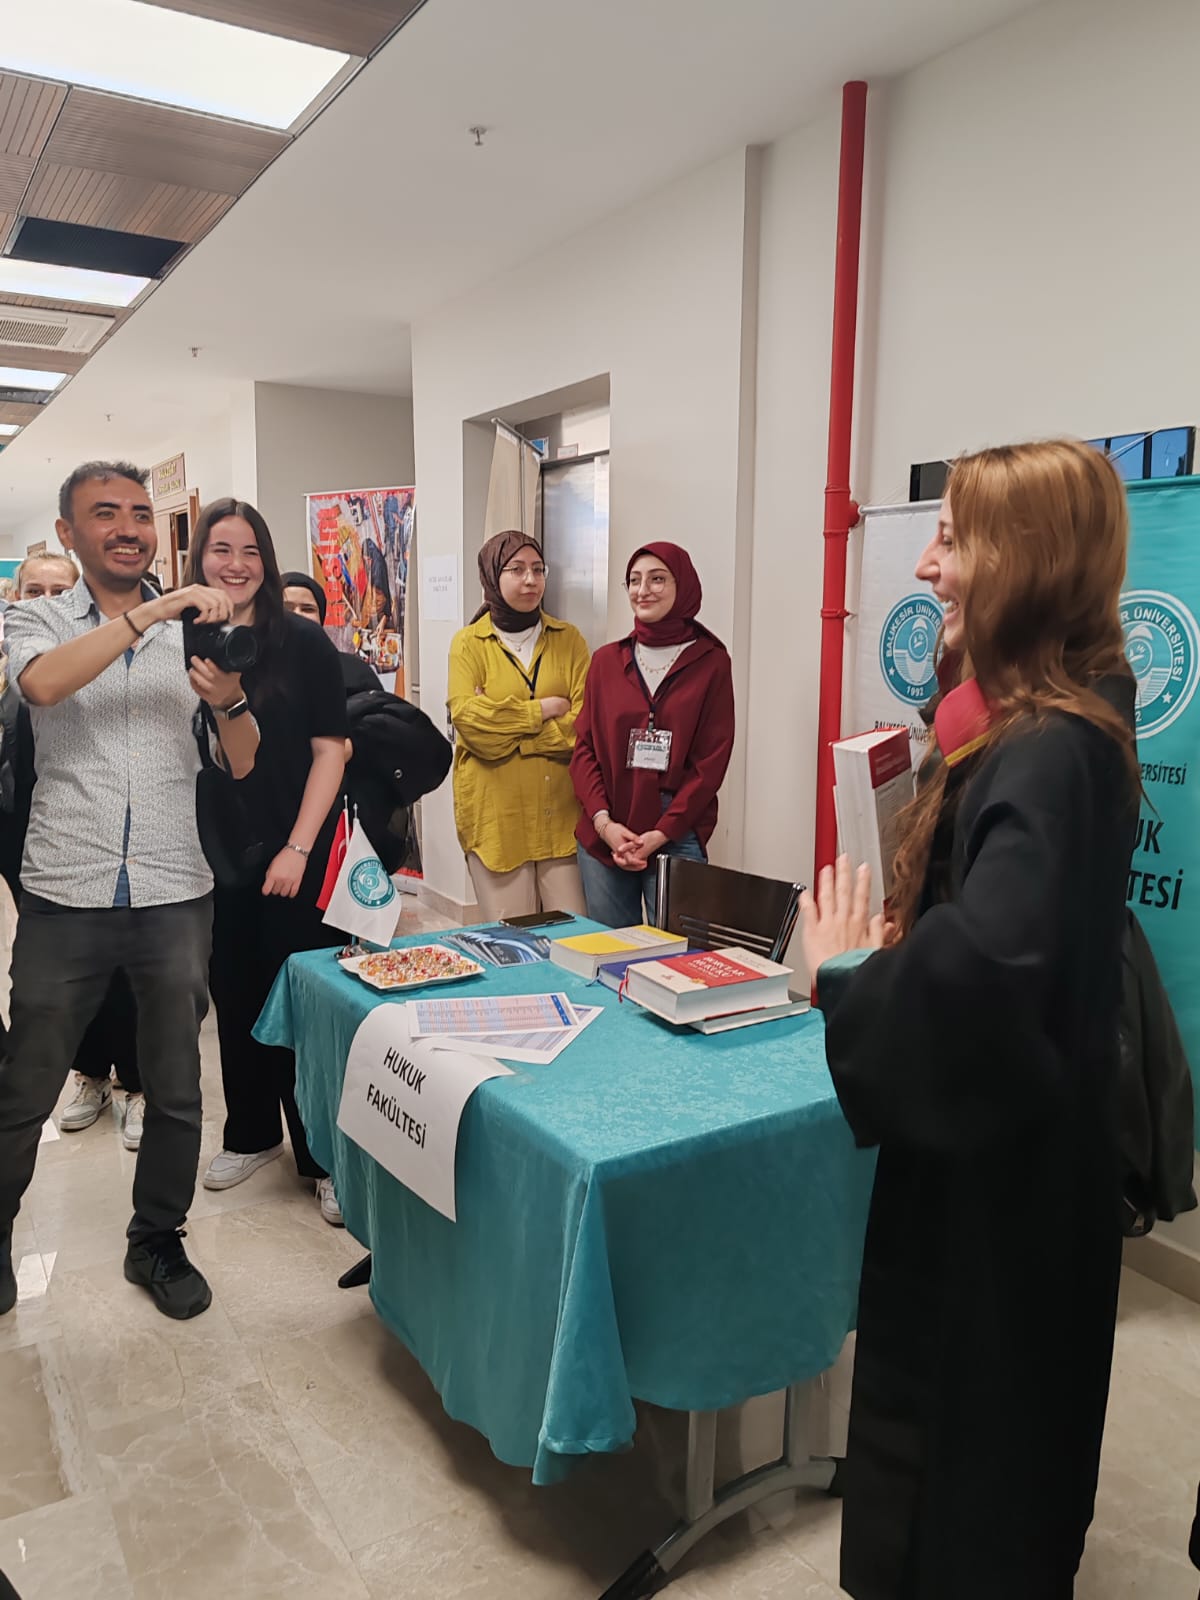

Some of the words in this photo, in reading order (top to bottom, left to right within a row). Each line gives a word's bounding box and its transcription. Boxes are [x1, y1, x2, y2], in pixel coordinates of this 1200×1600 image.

[886, 606, 914, 657] BALIKESİR
[916, 602, 941, 630] ÜNİVER
[1134, 606, 1185, 682] ÜNİVERSİTESİ
[1140, 760, 1187, 785] ERSİTESİ
[1127, 869, 1183, 910] TESİ
[384, 1046, 426, 1095] HUKUK
[366, 1083, 427, 1149] FAKÜLTESİ
